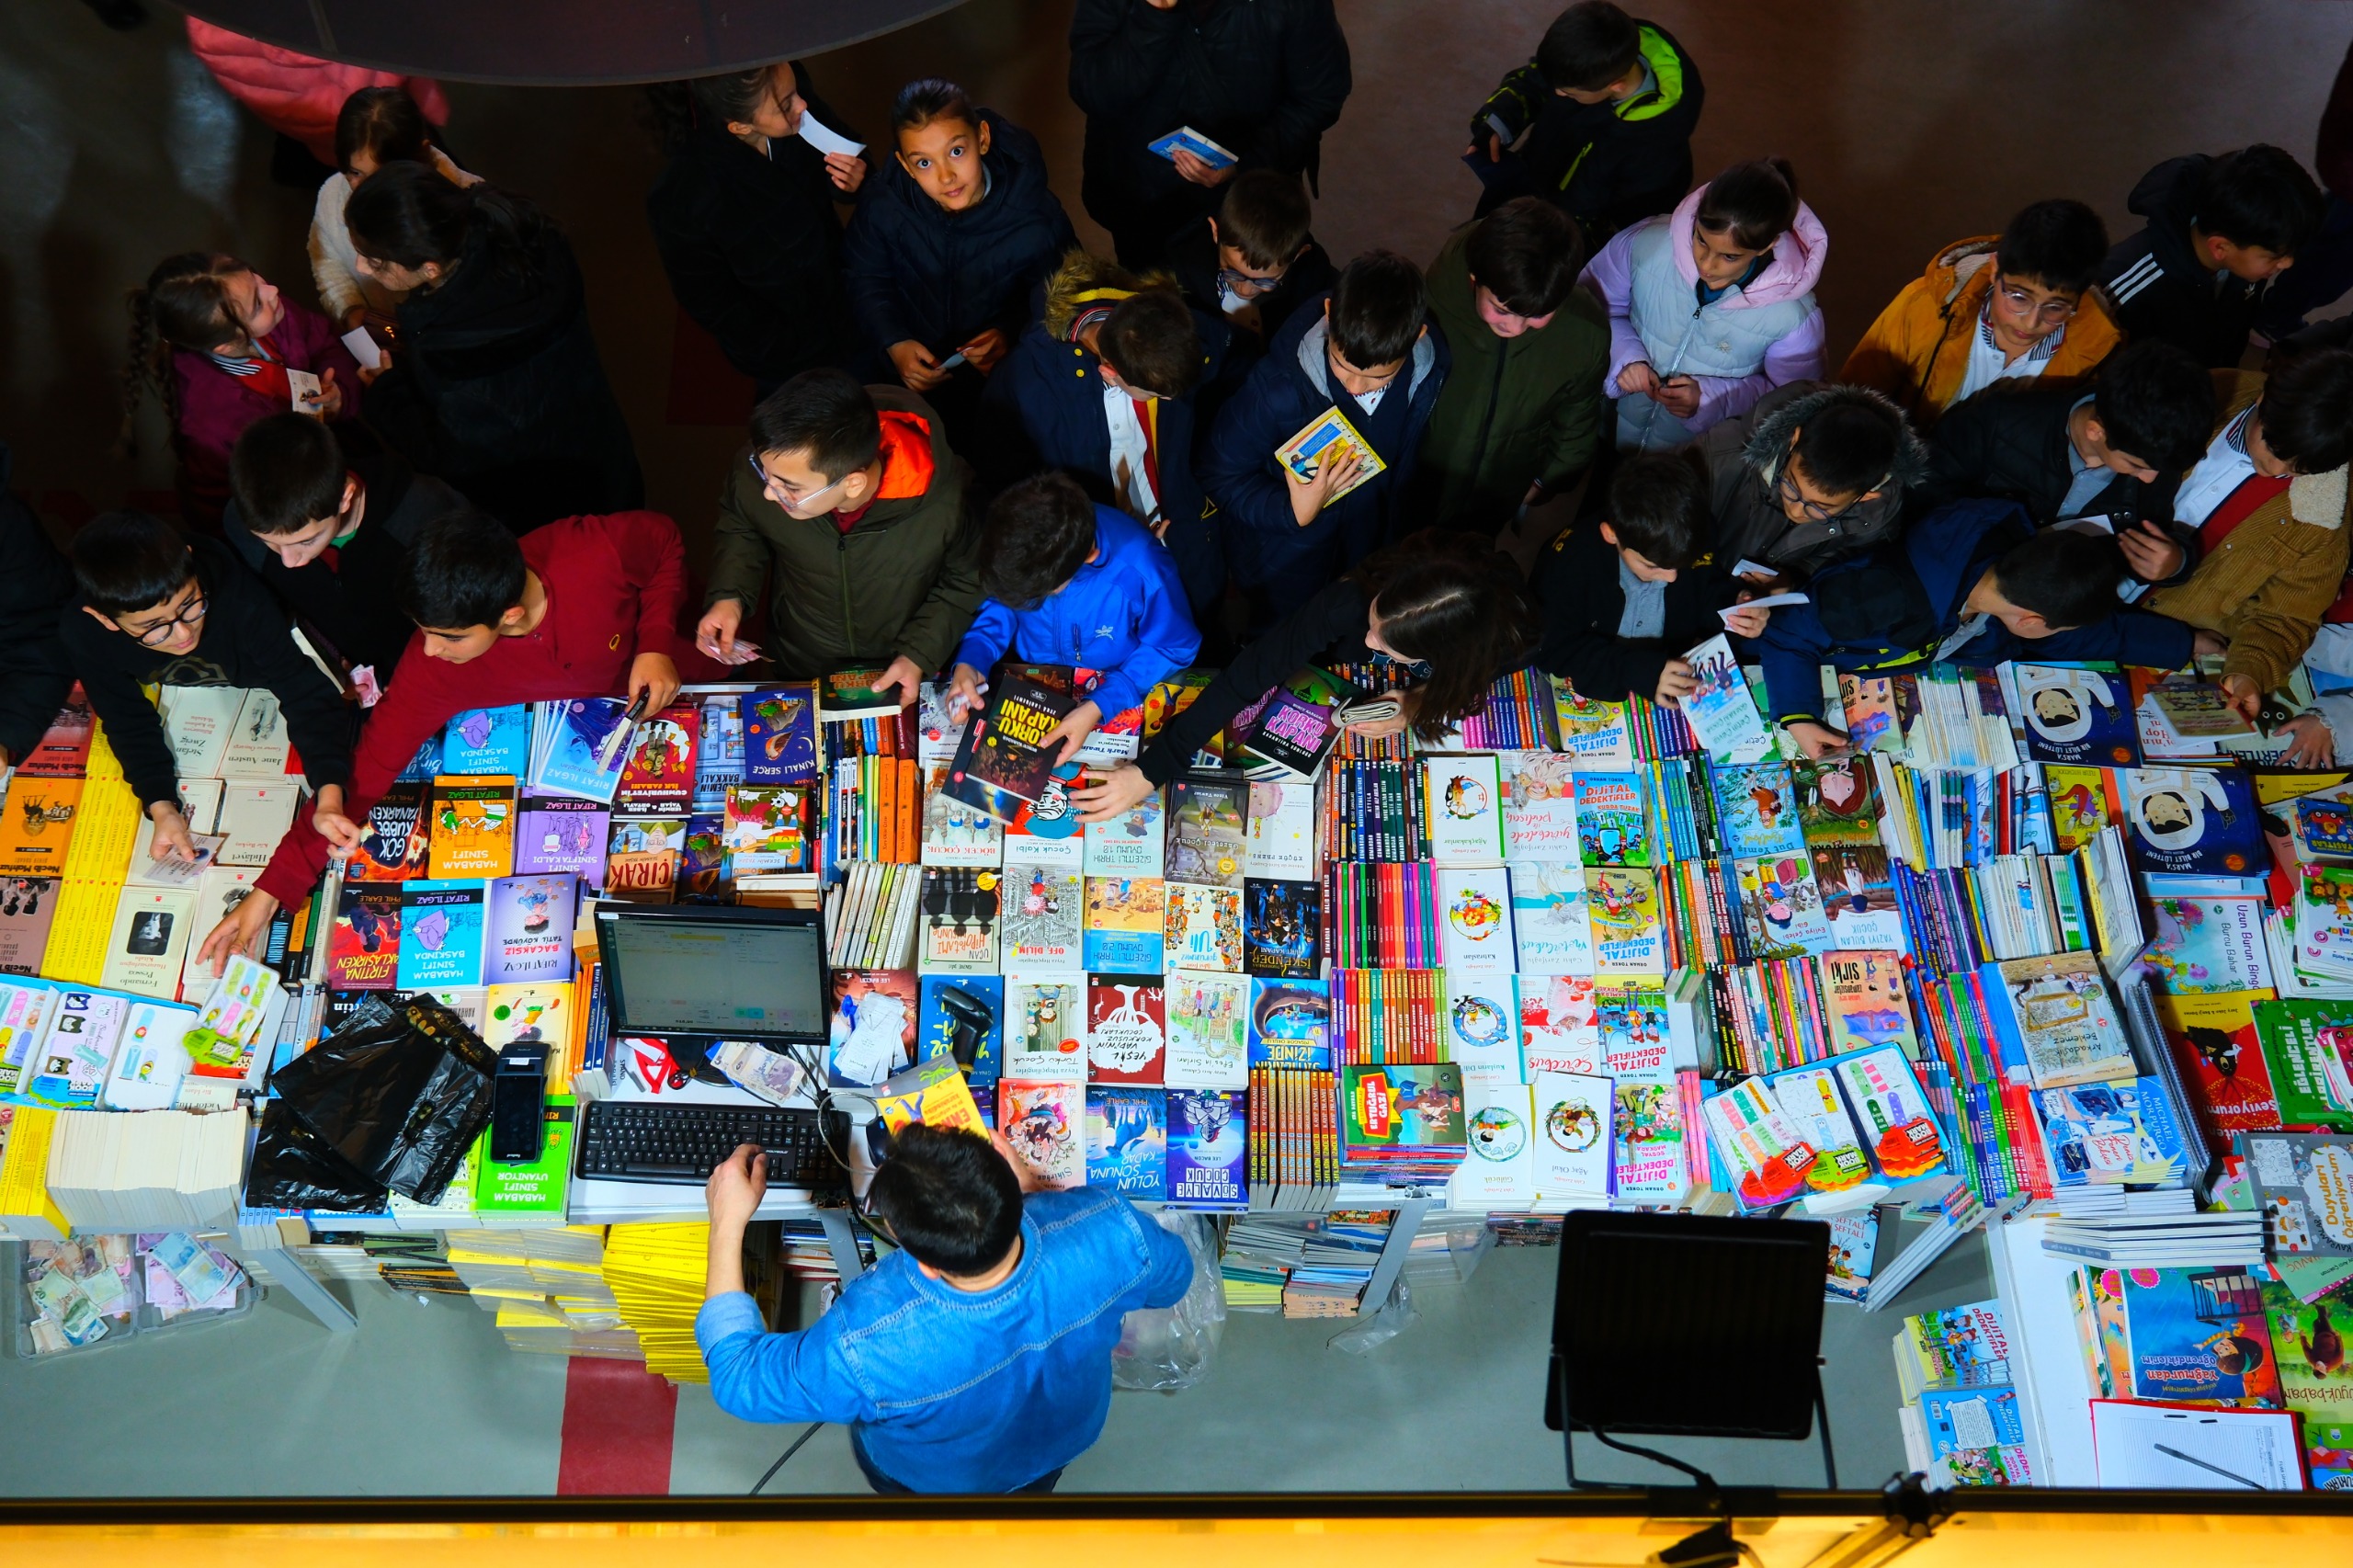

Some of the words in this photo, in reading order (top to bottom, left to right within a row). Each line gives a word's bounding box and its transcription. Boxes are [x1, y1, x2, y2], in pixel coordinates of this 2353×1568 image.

[1277, 705, 1327, 737] KORKU
[1265, 716, 1323, 754] KAPANI
[180, 736, 206, 747] Zweig
[176, 747, 203, 756] Stefan
[460, 748, 508, 757] BASKINDA
[262, 756, 282, 765] Jane
[460, 766, 508, 774] HABABAM
[753, 766, 781, 774] SERÇE
[785, 760, 814, 773] KINALI
[547, 768, 578, 781] ILGAZ
[701, 774, 740, 783] BAKKALI
[581, 777, 610, 790] RIFAT
[369, 806, 418, 821] YANARKEN
[377, 821, 414, 837] KUBBE
[1176, 837, 1201, 846] Çocuk
[381, 837, 405, 861] GÖK
[452, 850, 488, 858] SINIFI
[927, 846, 961, 856] ÇOCUK
[963, 846, 995, 856] BÖCEK
[1016, 846, 1038, 854] Kalbi
[1041, 845, 1071, 854] Çocuk
[232, 852, 267, 862] Hidâyet
[443, 860, 497, 869] HABABAM
[608, 858, 669, 888] ÇIRAK
[445, 894, 470, 903] RIFAT
[2236, 905, 2248, 935] Uzun
[1850, 922, 1878, 934] ÇOCUK
[540, 936, 562, 945] TATİL
[505, 945, 559, 955] BACAKSIZ
[2240, 932, 2253, 961] Burun
[415, 950, 465, 960] BASKINDA
[423, 960, 455, 969] SINIFI
[529, 959, 557, 970] RIFAT
[128, 971, 153, 979] Pessoa
[346, 965, 389, 980] FIRTINA
[414, 971, 463, 979] HABABAM
[1830, 961, 1859, 983] sirki
[120, 978, 157, 987] Fernando
[1367, 1081, 1378, 1130] ERTUĞRUL
[1378, 1093, 1387, 1118] GAZİ
[1906, 1122, 1927, 1137] MARK
[1909, 1128, 1932, 1142] BOOK
[1122, 1150, 1156, 1164] KADAR
[1784, 1145, 1804, 1162] MARK
[1788, 1150, 1810, 1167] BOOK
[1835, 1151, 1857, 1162] MARK
[1838, 1156, 1860, 1168] BOOK
[1090, 1164, 1141, 1178] SONUNA
[1186, 1168, 1229, 1183] ÇOCUK
[497, 1173, 548, 1181] UYANIYOR
[1117, 1174, 1159, 1190] YOLUN
[504, 1183, 538, 1192] SINIFI
[1176, 1182, 1238, 1198] ŞÖVALYE
[494, 1192, 545, 1202] HABABAM
[2146, 1369, 2219, 1383] Yağmurdan
